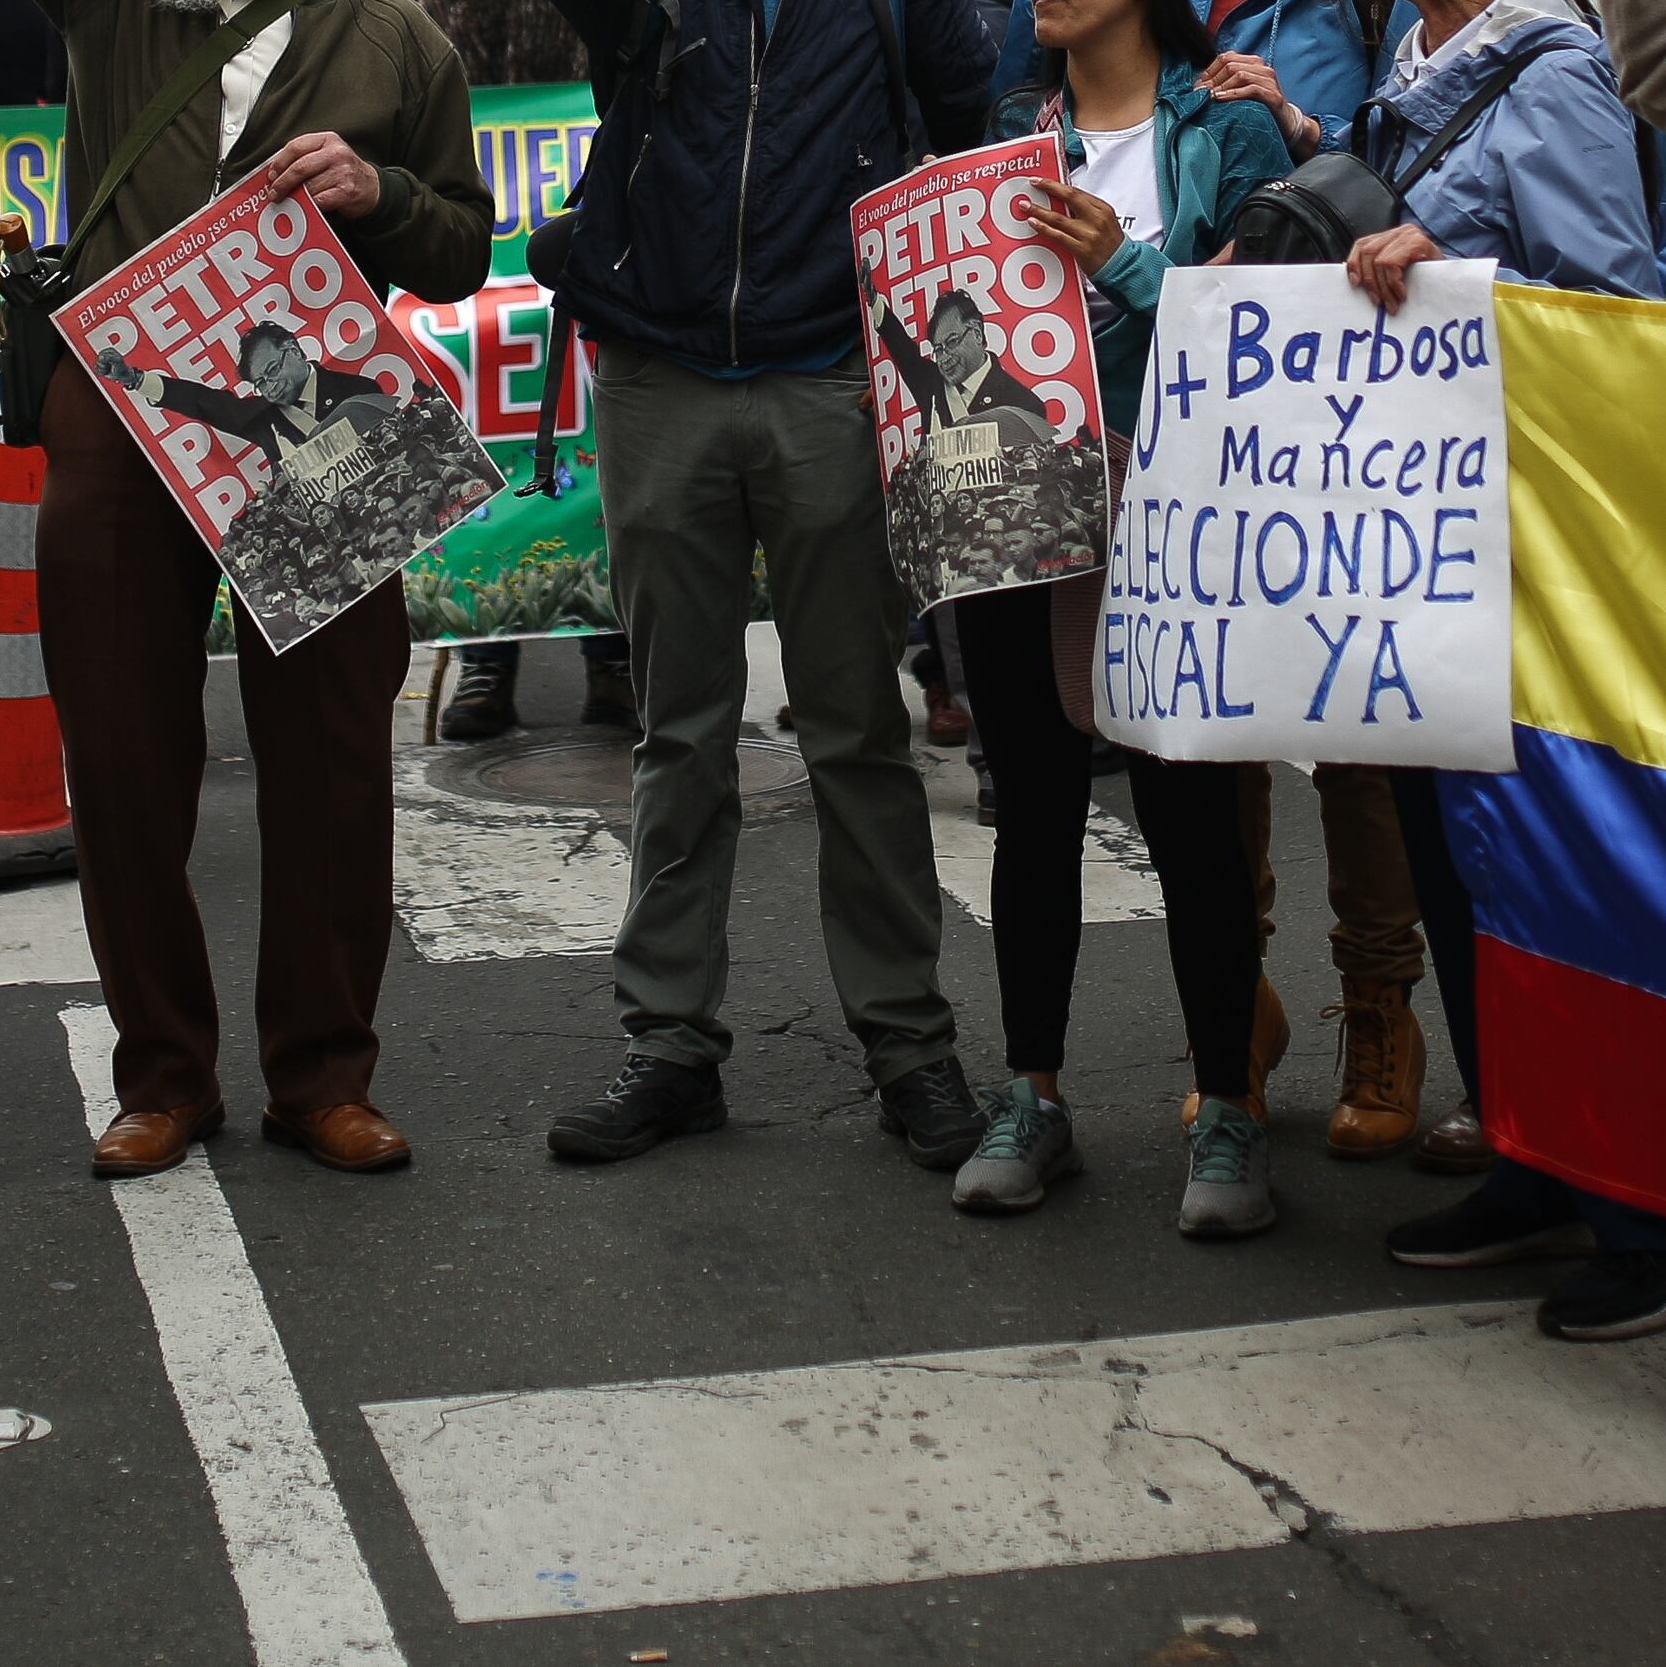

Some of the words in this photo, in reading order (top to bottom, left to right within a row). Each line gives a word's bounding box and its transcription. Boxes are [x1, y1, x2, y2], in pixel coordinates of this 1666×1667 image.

[858, 209, 868, 229] El
[867, 204, 890, 225] voto
[891, 189, 910, 212] del
[908, 173, 949, 208] pueblo
[973, 149, 1042, 181] respeta!
[858, 175, 1052, 281] PETRO
[78, 310, 97, 329] El
[98, 287, 131, 315] voto
[131, 263, 157, 291] del
[155, 230, 207, 282] pueblo
[85, 196, 308, 356] PETRO
[1227, 300, 1490, 400] Barbosa
[1218, 425, 1488, 497] Mancera
[1104, 613, 1255, 721] FISCAL
[1302, 614, 1424, 724] YA
